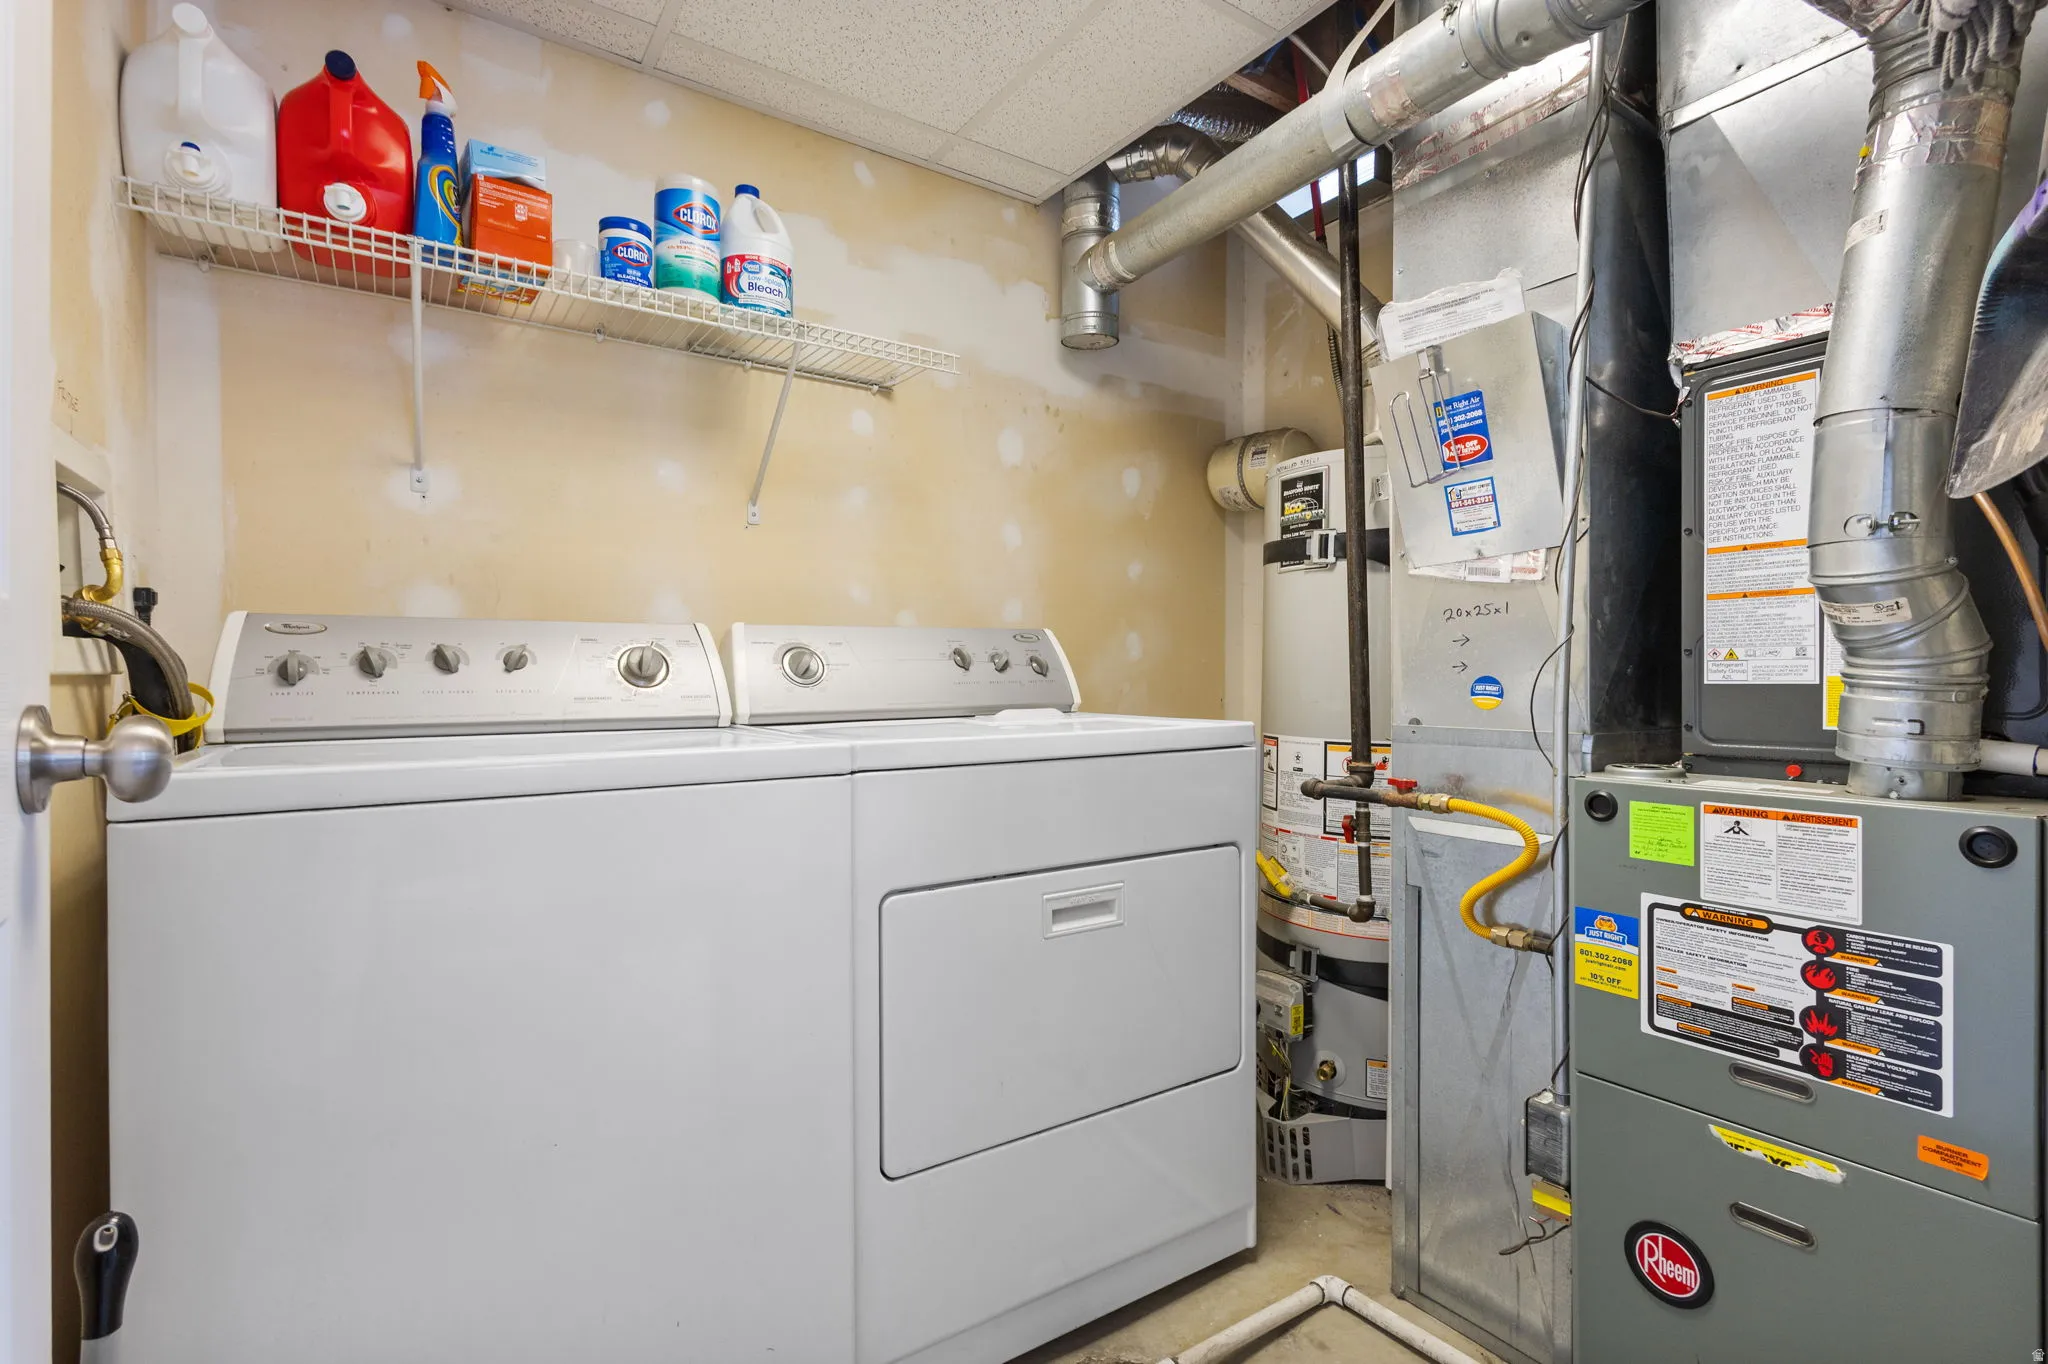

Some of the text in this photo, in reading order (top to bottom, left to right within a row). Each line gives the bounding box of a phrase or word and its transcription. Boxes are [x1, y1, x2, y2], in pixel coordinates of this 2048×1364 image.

[680, 208, 717, 232] CLOROX
[617, 246, 649, 265] CLOROX
[748, 281, 784, 299] Bleach
[1743, 379, 1783, 393] WARNING
[1755, 384, 1797, 397] FLAMMABLE
[1453, 396, 1481, 409] Right Air
[1708, 400, 1755, 413] REFRIGERANT
[1708, 410, 1742, 421] REPAIRED
[1743, 405, 1762, 415] ONLY
[1776, 397, 1807, 408] TRAINED
[1708, 417, 1738, 428] SERVICE
[1798, 403, 1812, 411] NOT
[1708, 414, 1797, 435] PUNCTURE REFRIGERANT
[1757, 431, 1788, 441] DISPOSE
[1789, 429, 1800, 437] OF
[1708, 446, 1744, 456] PROPERLY
[1754, 436, 1805, 449] ACCORDANCE
[1708, 456, 1726, 464] WITH
[1727, 452, 1757, 461] FEDERAL
[1772, 446, 1795, 454] LOCAL
[1757, 451, 1801, 463] FLAMMABLE
[1708, 466, 1755, 478] REFRIGERANT
[1757, 468, 1793, 478] AUXILIARY
[1304, 483, 1320, 491] WHITE
[1708, 484, 1737, 493] DEVICES
[1739, 480, 1761, 488] WHICH
[1708, 483, 1797, 500] IGNITION SOURCES SHALL
[1735, 494, 1771, 503] INSTALLED
[1750, 498, 1796, 510] OTHER THAN
[1708, 505, 1801, 521] AUXILIARY DEVICES LISTED
[1738, 517, 1756, 525] WITH
[1708, 527, 1739, 536] SPECIFIC
[1443, 601, 1509, 622] 20x25x1
[1720, 807, 1768, 818] WARNING
[1791, 814, 1853, 827] AVERTISSEMENT
[1702, 911, 1754, 927] WARNING
[1588, 929, 1624, 942] JUST RIGHT
[1706, 926, 1727, 934] SAFETY
[1728, 931, 1769, 942] INFORMATION
[1866, 936, 1893, 946] MONOXIDE
[1912, 945, 1938, 954] RELEASED
[1579, 949, 1633, 966] 801.302.2068
[1656, 945, 1748, 967] INSTALLER SAFETY INFORMATION
[1840, 955, 1870, 965] WARNING
[1590, 972, 1622, 985] 10% OFF
[1841, 992, 1872, 1002] WARNING
[1829, 998, 1852, 1008] NATURAL
[1880, 1009, 1894, 1017] LEAK
[1909, 1016, 1935, 1026] EXPLODE
[1842, 1042, 1873, 1053] WARNING
[1846, 1053, 1919, 1077] HAZARDOUS VOLTAGE!
[1841, 1081, 1872, 1092] WARNING
[1922, 1145, 1983, 1168] COMPARTMENT
[1936, 1144, 1969, 1158] BURNER
[1940, 1156, 1964, 1167] DOOR
[1644, 1236, 1696, 1289] Rheem
